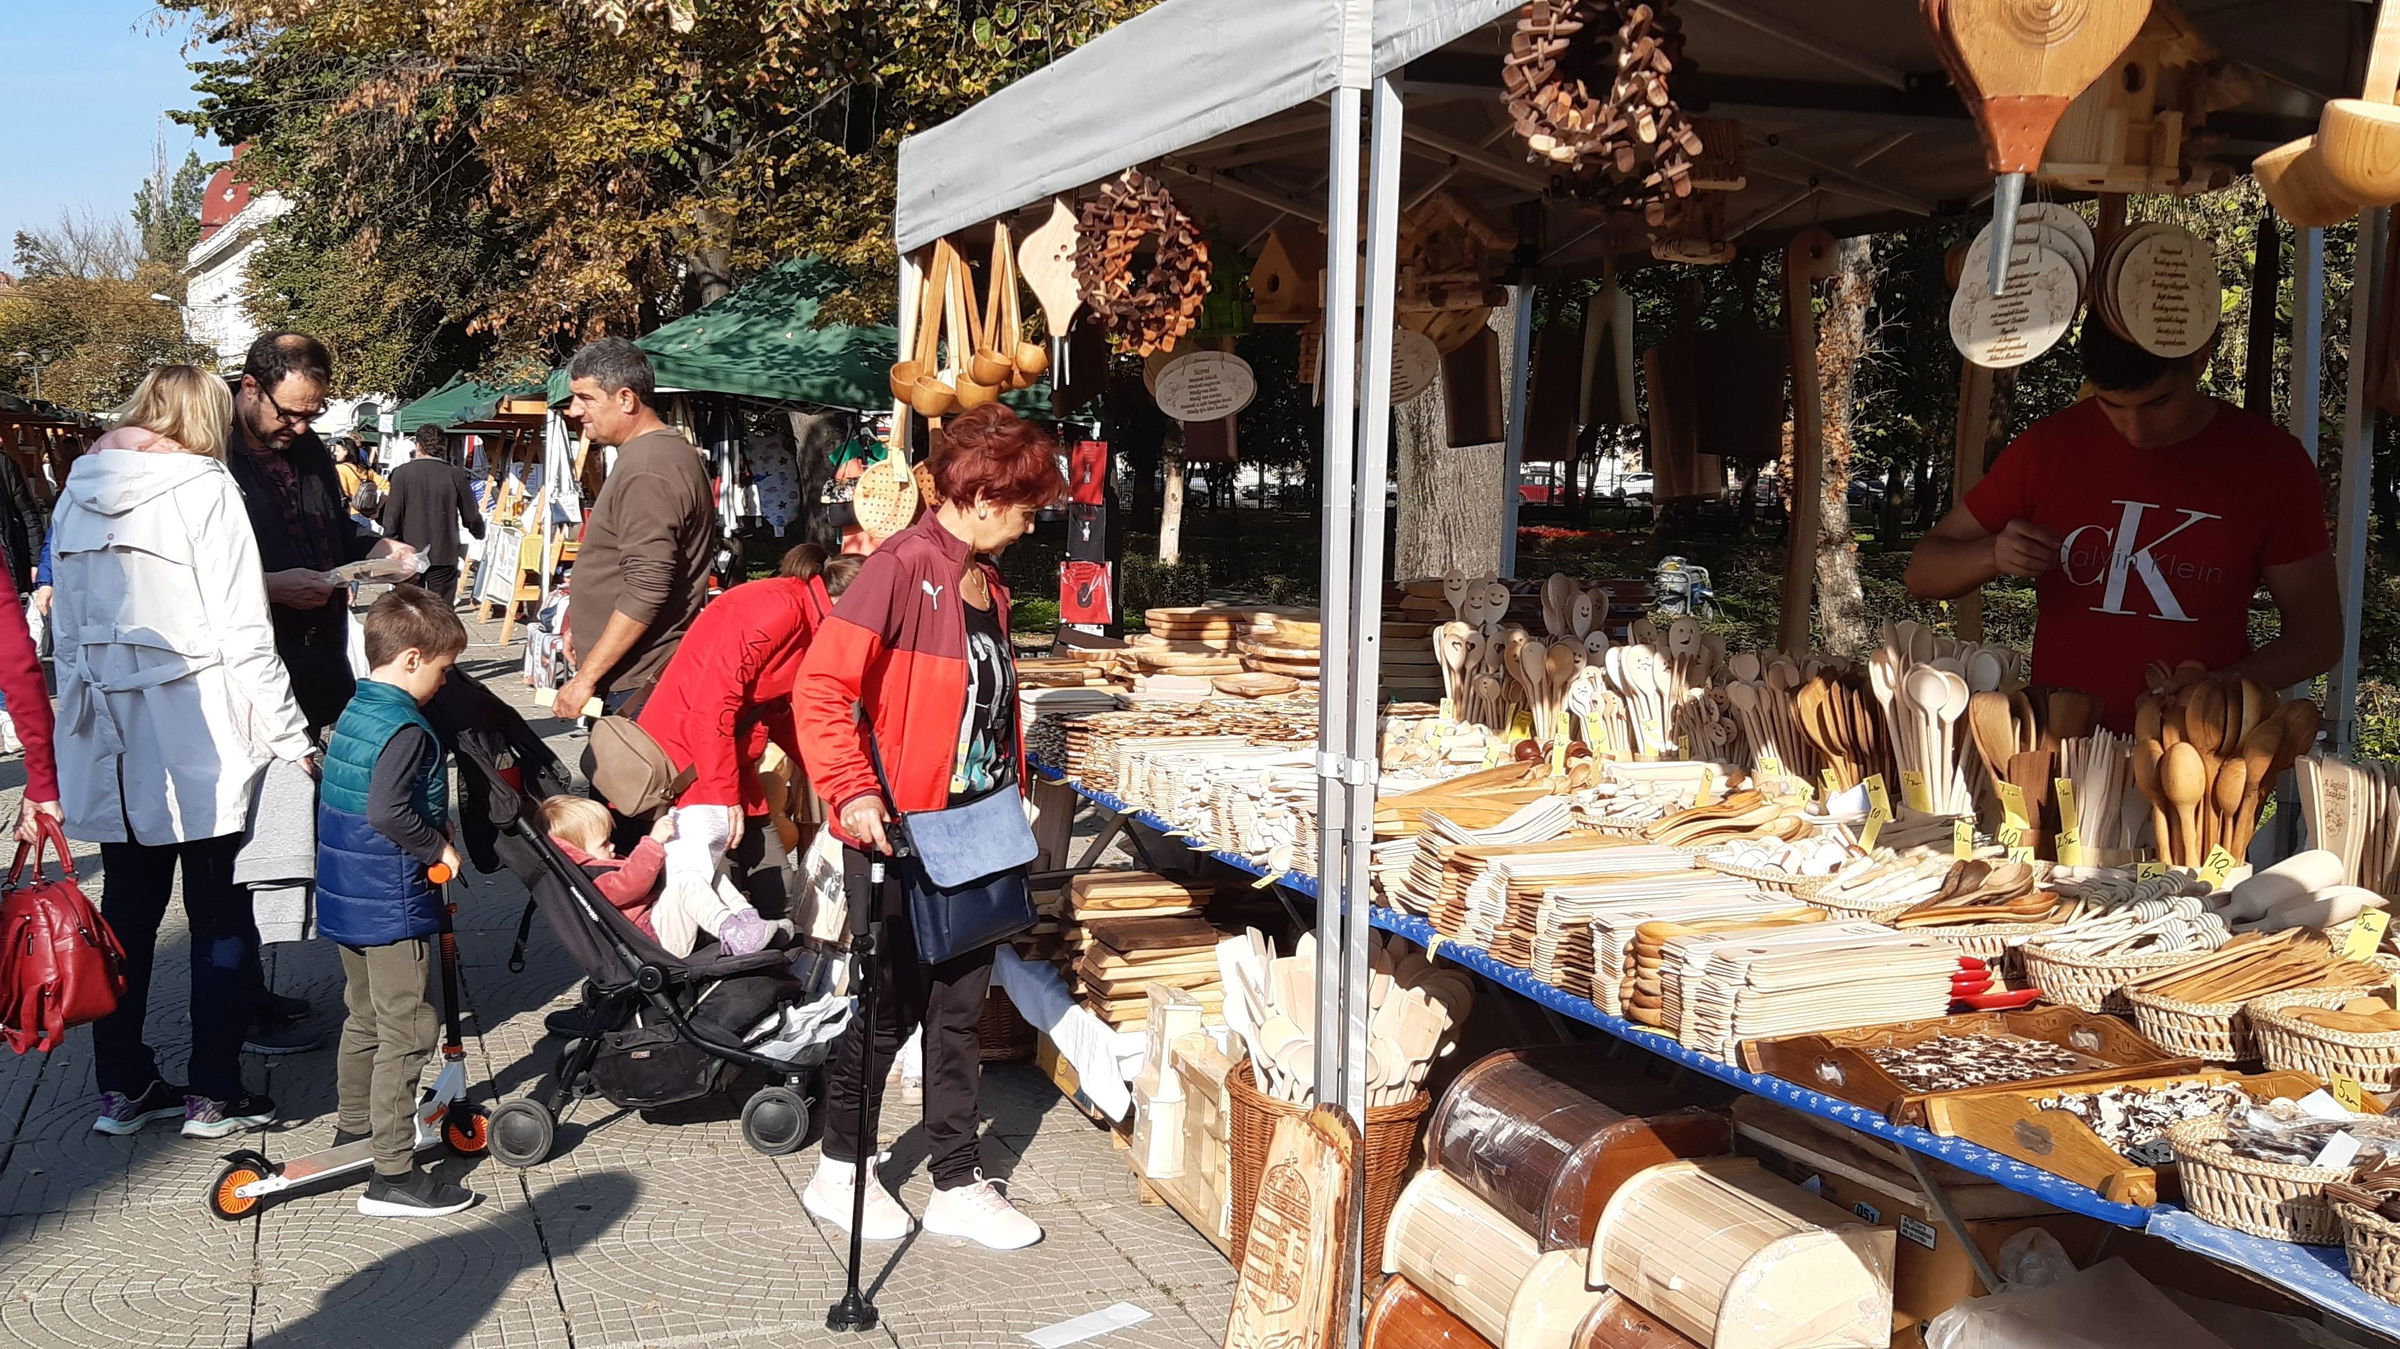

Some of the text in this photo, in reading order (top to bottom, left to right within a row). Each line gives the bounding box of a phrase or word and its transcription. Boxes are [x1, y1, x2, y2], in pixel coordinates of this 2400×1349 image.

[2150, 552, 2223, 584] Klein
[2000, 828, 2018, 846] 10
[2207, 851, 2231, 870] 10
[2140, 866, 2153, 879] 6
[2358, 912, 2377, 926] 5
[2337, 1078, 2352, 1099] 5
[1856, 1203, 1876, 1225] 051
